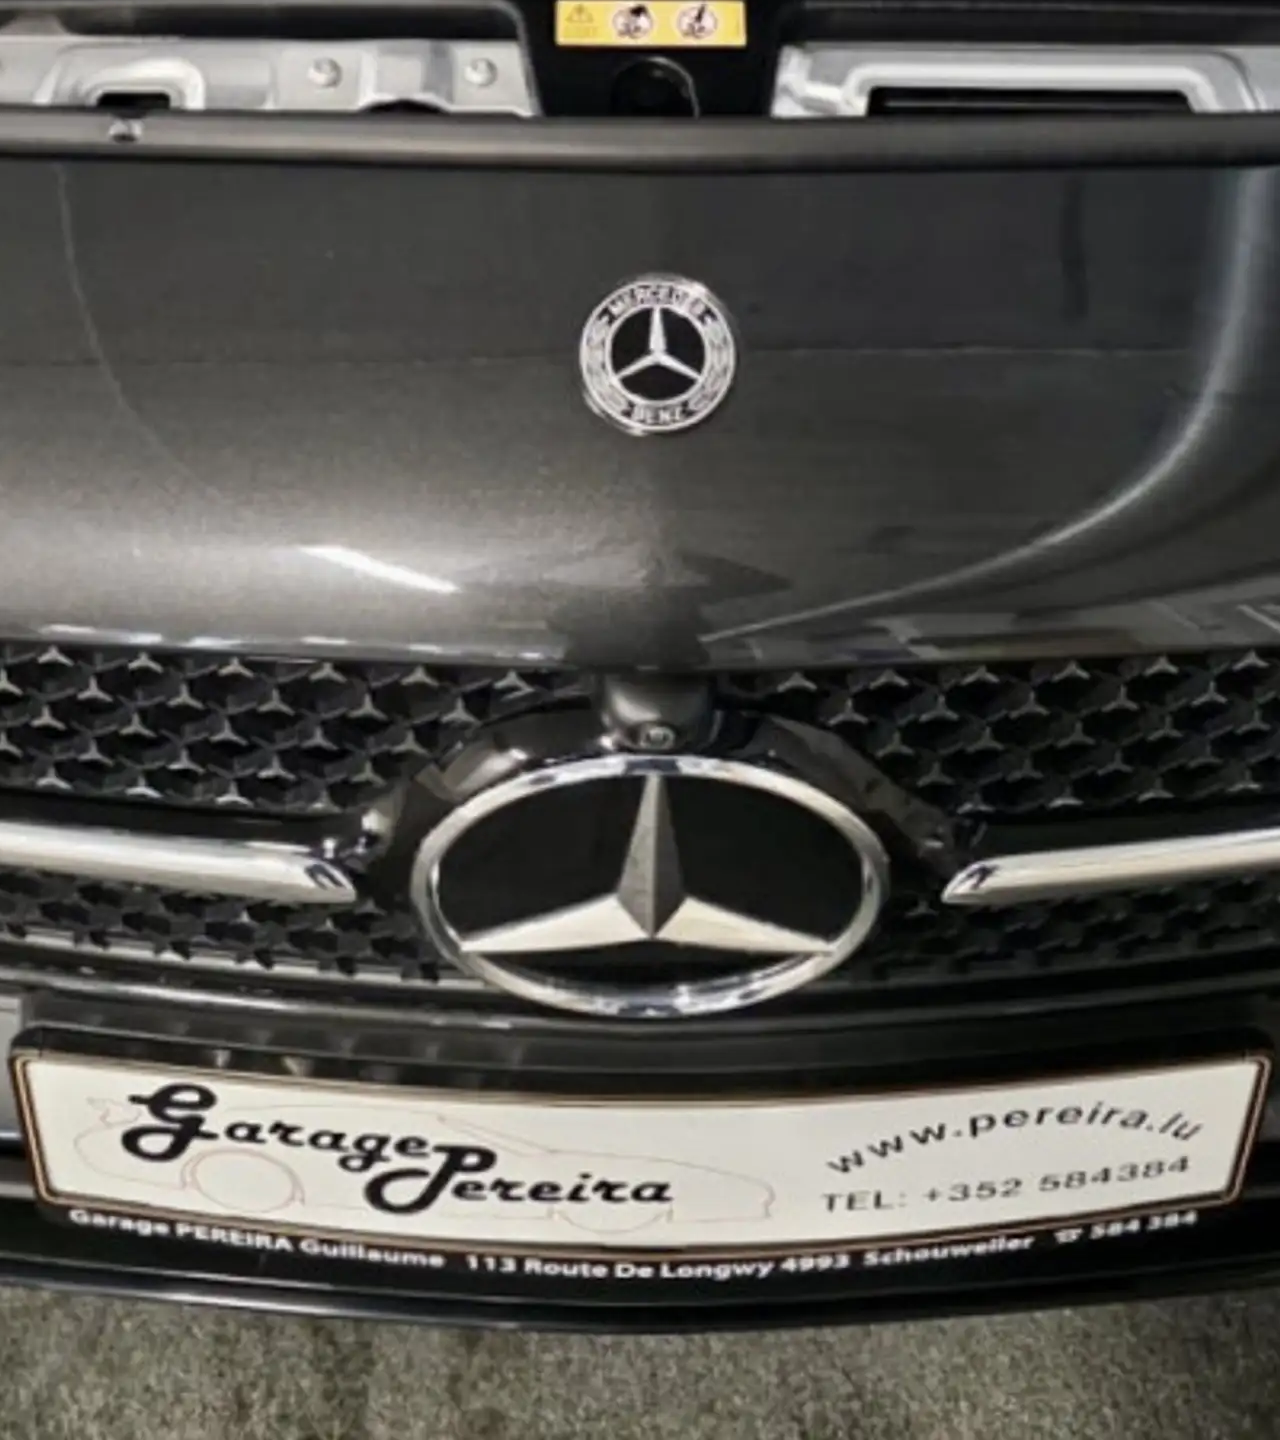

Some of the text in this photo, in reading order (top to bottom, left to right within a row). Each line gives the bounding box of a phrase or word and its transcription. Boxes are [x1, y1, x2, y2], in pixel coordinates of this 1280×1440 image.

[121, 1082, 673, 1215] Garage Pereira
[826, 1101, 1203, 1174] www.pereira.lu
[821, 1155, 1190, 1213] TEL: +352 584384
[70, 1209, 1198, 1281] Garage PEREIRA Guillaume 113 Route De Longwy 4993 Schouweiler 584 384
